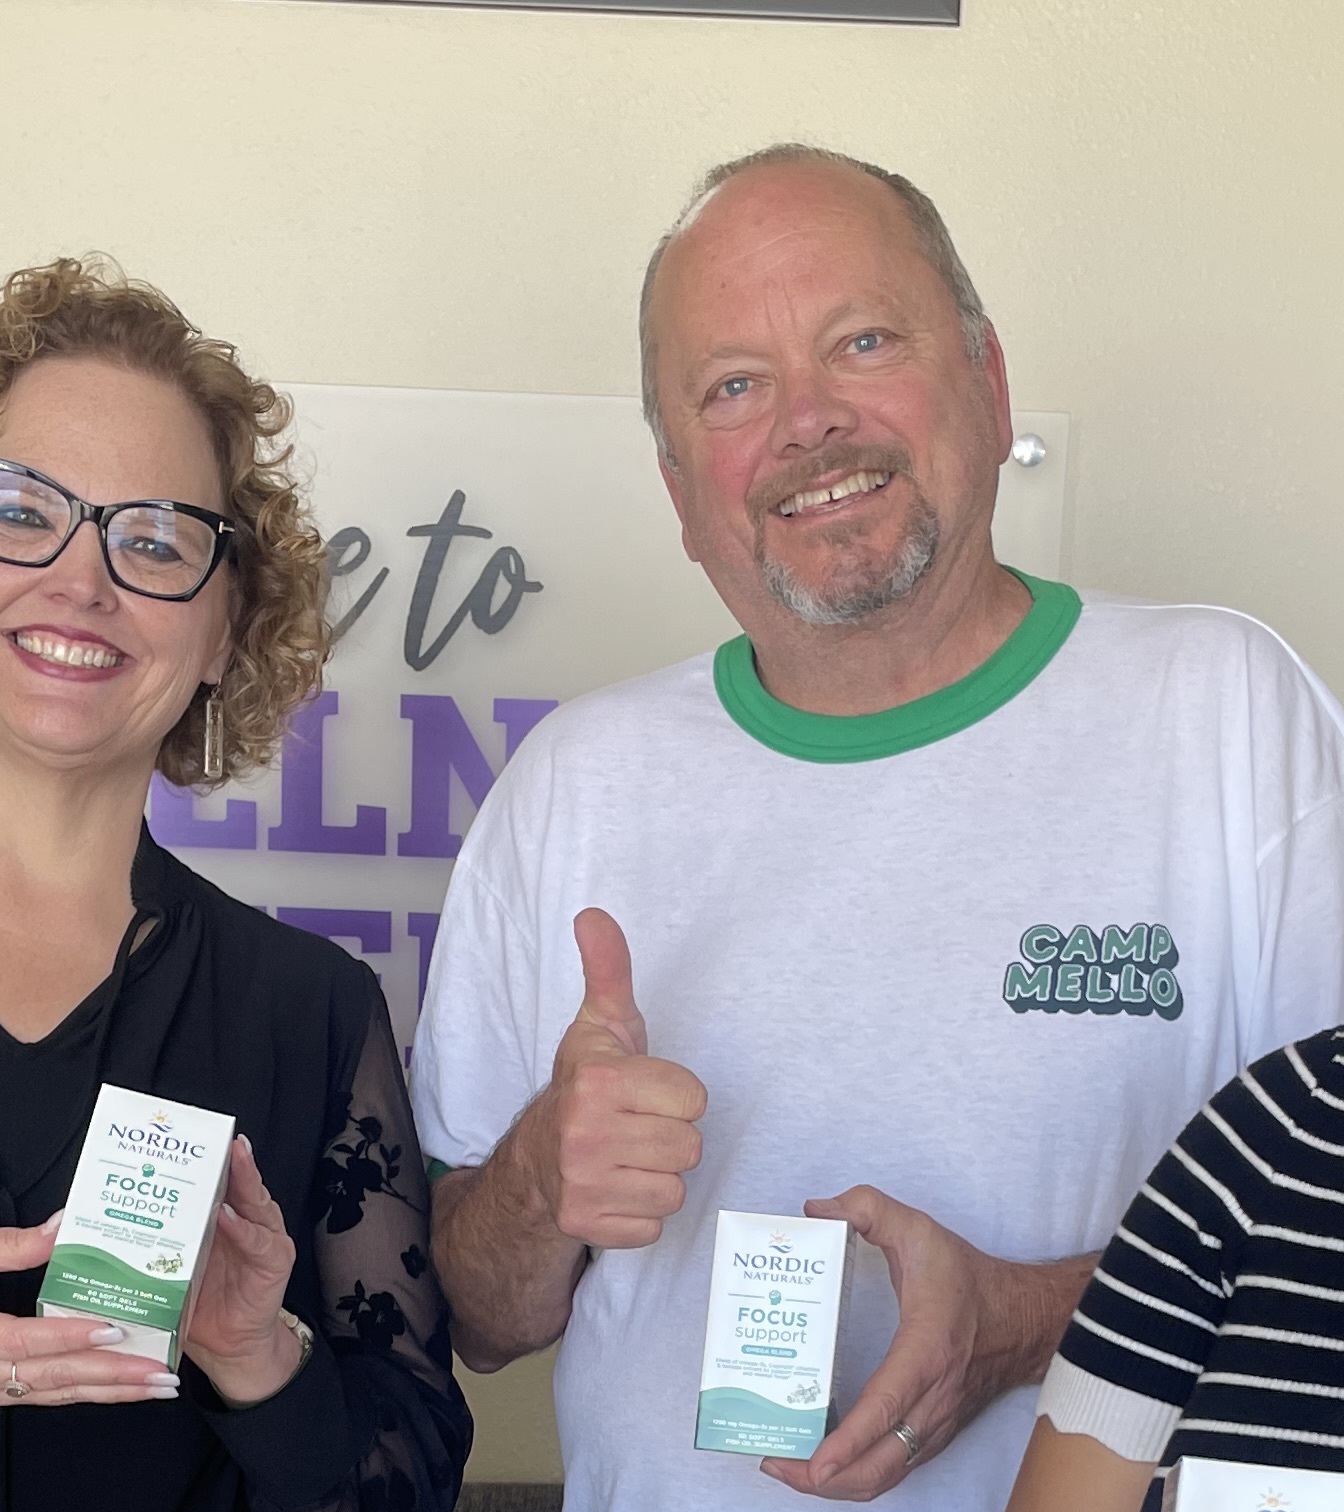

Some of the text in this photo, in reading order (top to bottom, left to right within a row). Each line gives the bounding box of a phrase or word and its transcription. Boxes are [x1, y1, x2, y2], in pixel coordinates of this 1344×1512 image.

[404, 490, 543, 671] to
[1019, 922, 1179, 966] CAMP
[1003, 962, 1184, 1019] MELLO
[108, 1123, 206, 1159] NORDIC
[117, 1141, 190, 1166] NATURALS
[105, 1174, 180, 1203] FOCUS
[100, 1190, 177, 1218] support
[109, 1210, 159, 1226] OMEGA BLEND
[733, 1252, 826, 1274] NORDIC
[743, 1271, 813, 1285] NATURALS
[737, 1307, 808, 1327] FOCUS
[734, 1326, 807, 1344] support
